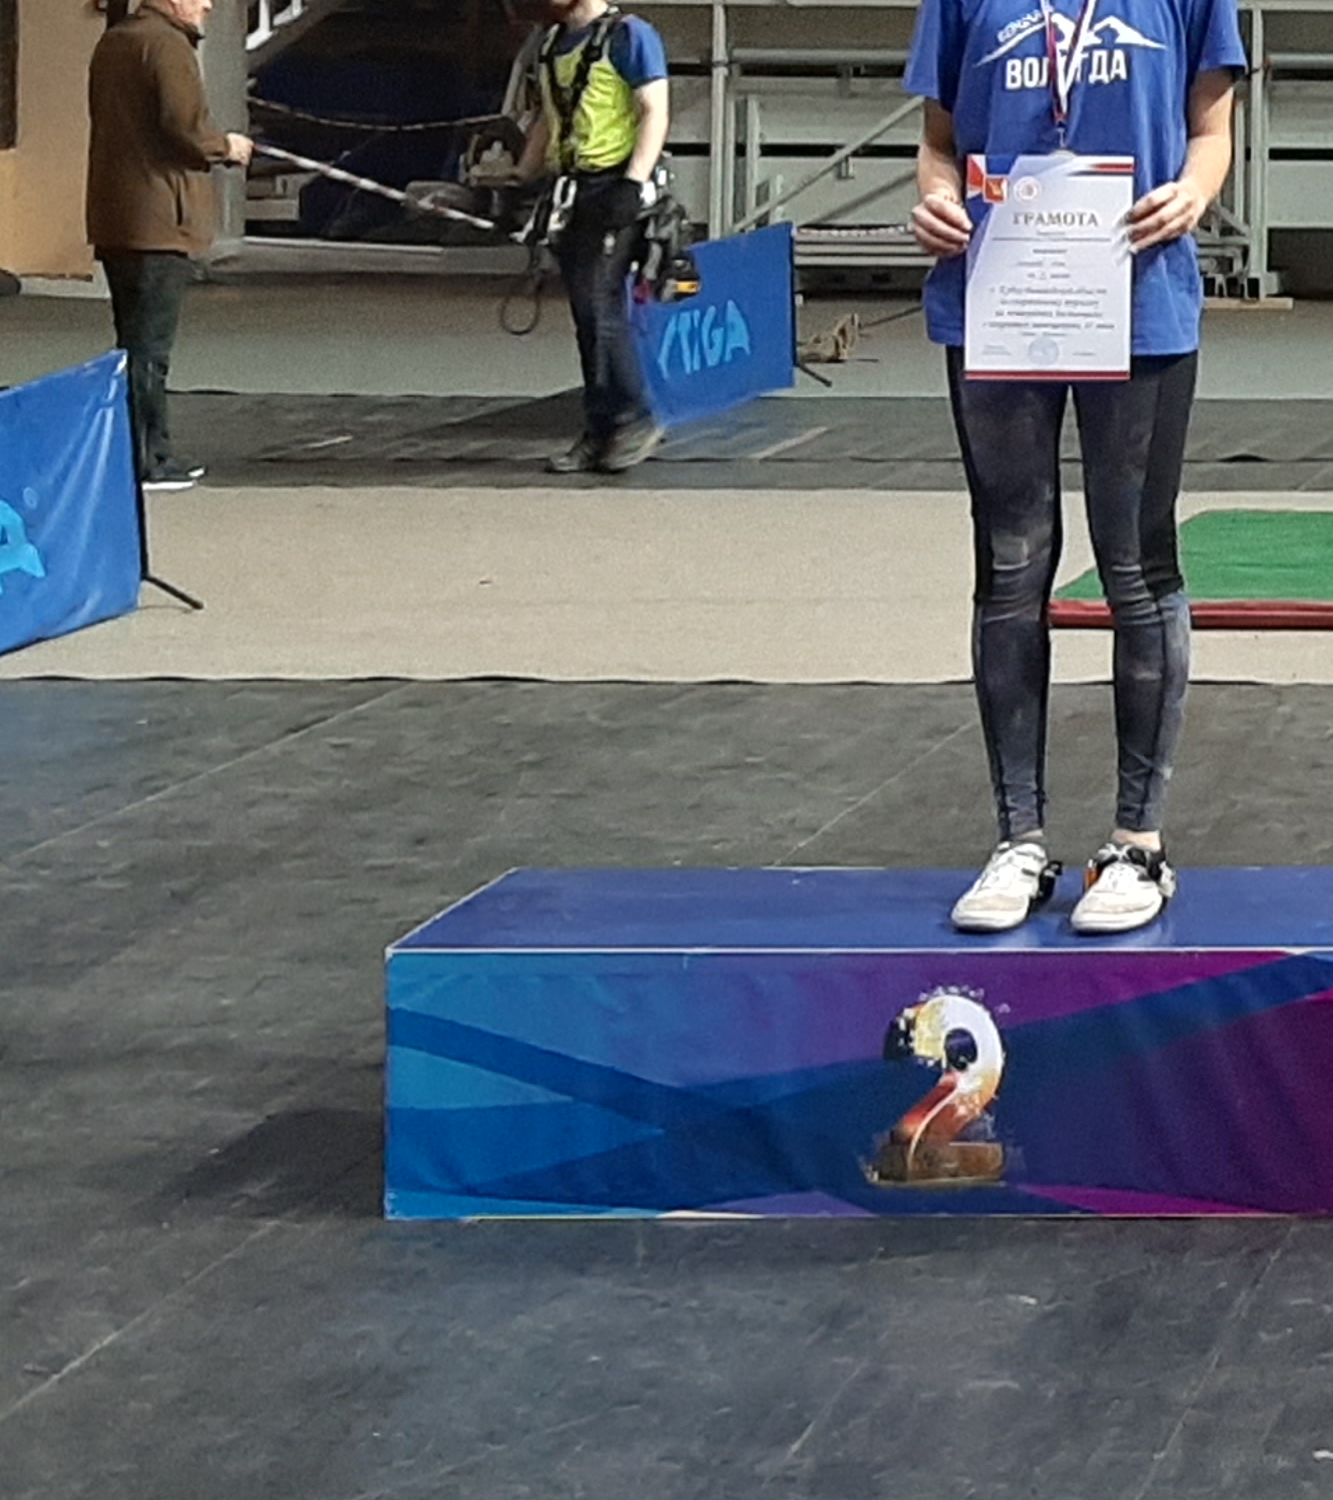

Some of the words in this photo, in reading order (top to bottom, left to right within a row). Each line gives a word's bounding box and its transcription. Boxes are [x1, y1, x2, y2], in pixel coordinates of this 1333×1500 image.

[1005, 48, 1128, 90] ВОЛГДА
[1012, 211, 1099, 227] ГРАМОТА
[882, 988, 1008, 1183] 2
